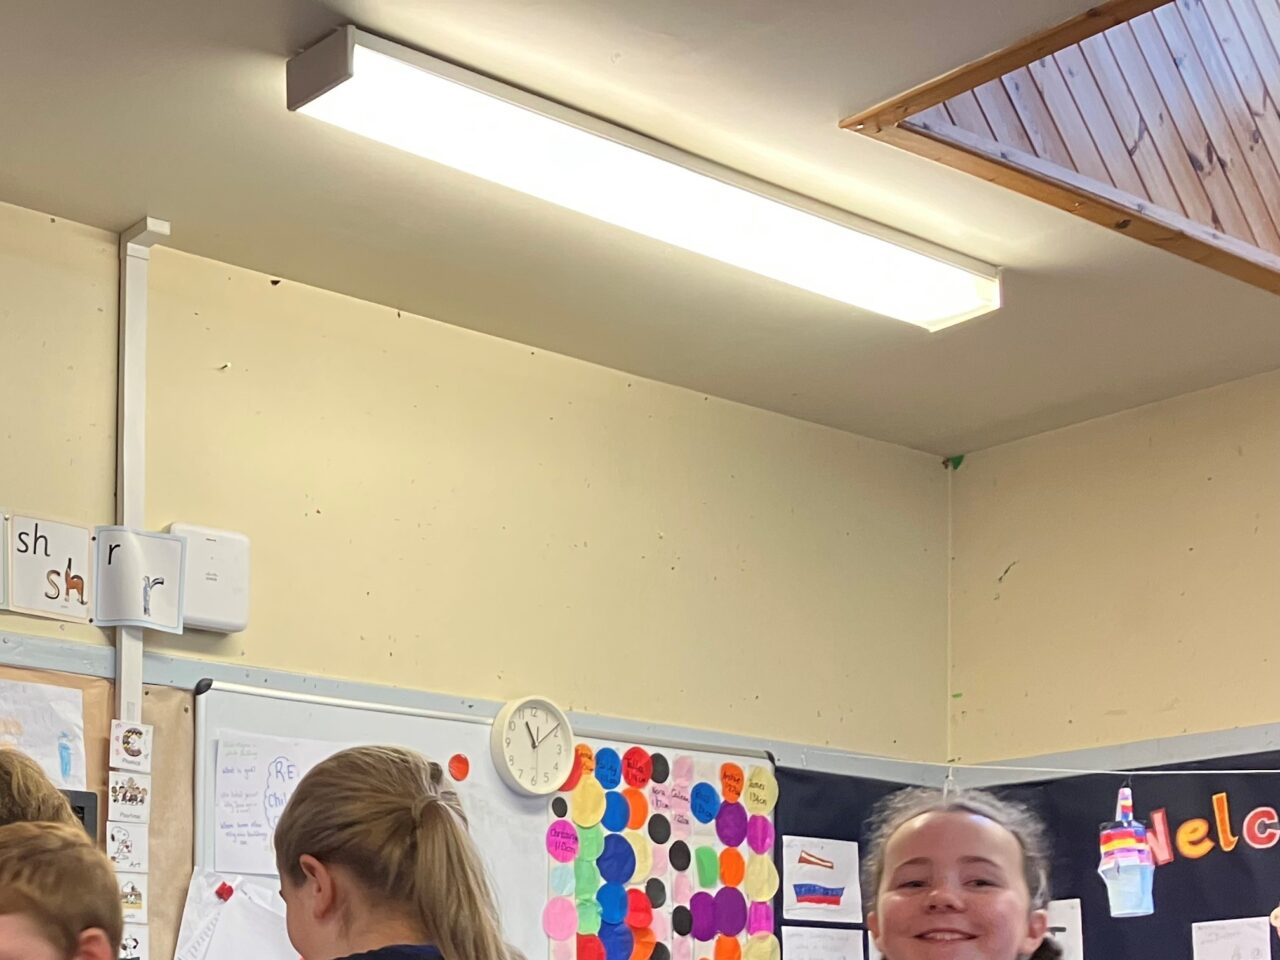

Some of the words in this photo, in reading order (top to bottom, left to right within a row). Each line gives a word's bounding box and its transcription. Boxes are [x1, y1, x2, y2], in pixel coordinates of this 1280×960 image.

[16, 523, 51, 557] sh
[108, 540, 123, 566] r
[45, 557, 88, 605] sh
[142, 574, 165, 617] r
